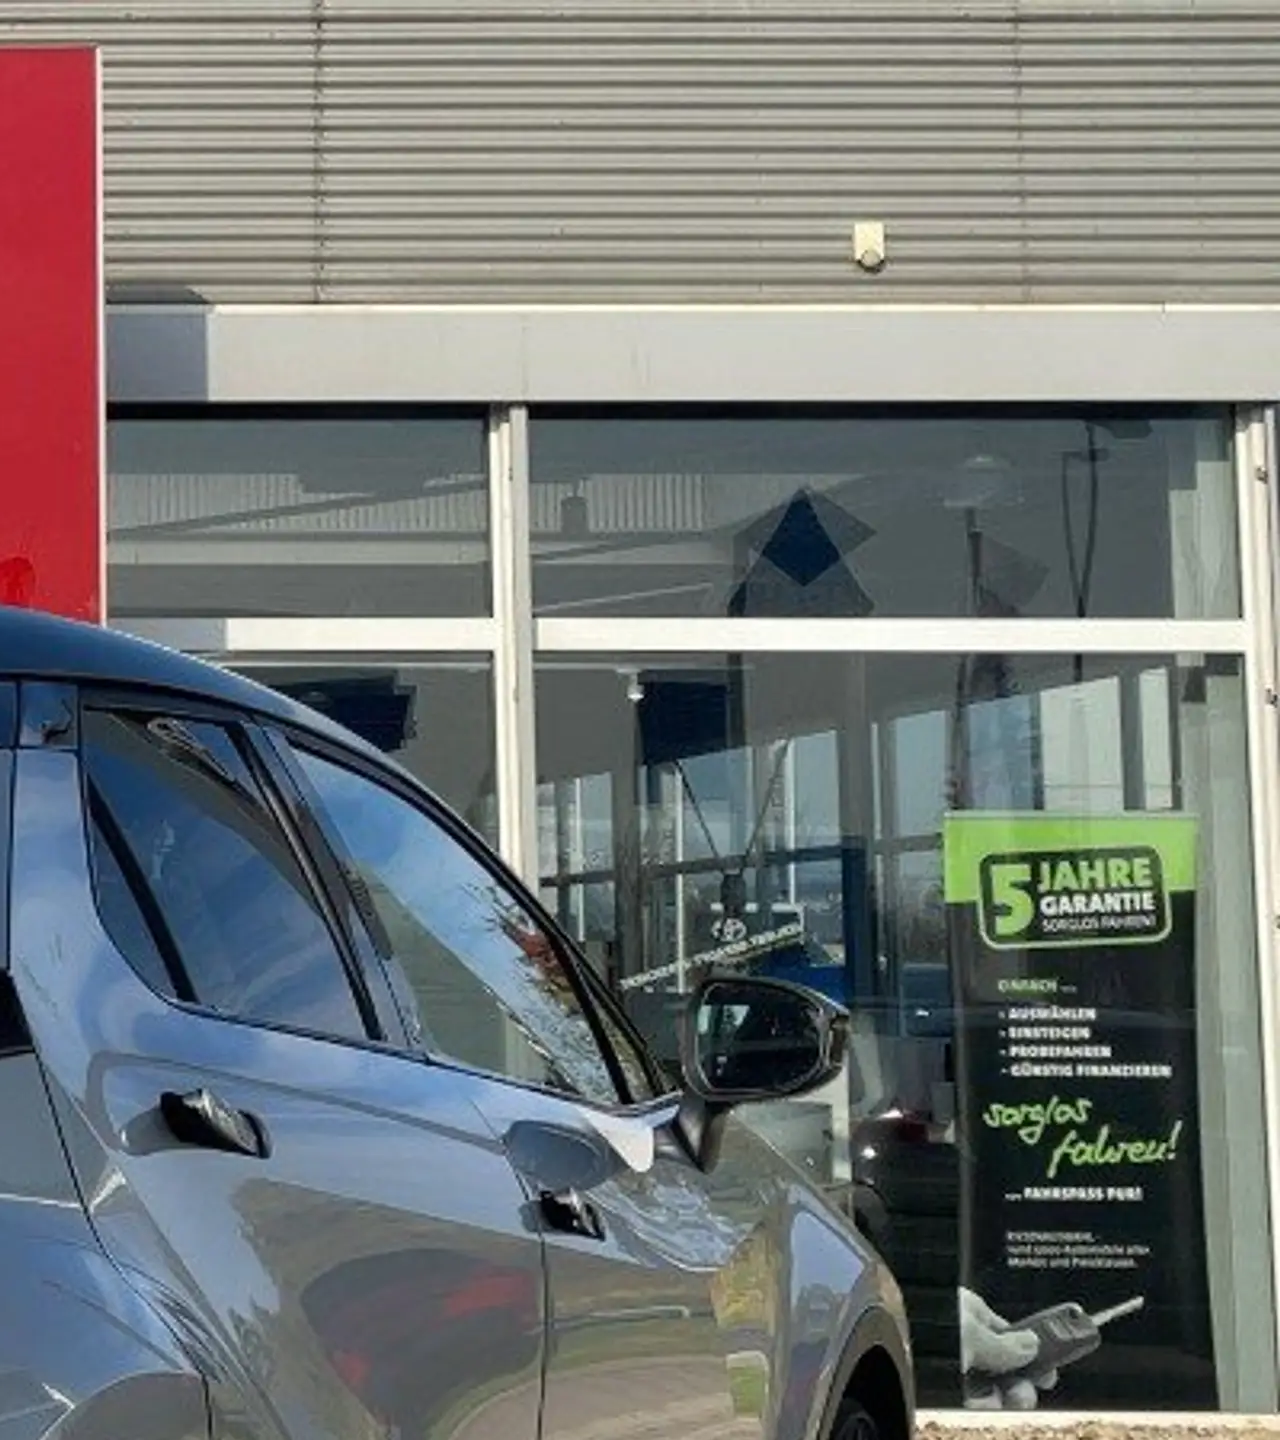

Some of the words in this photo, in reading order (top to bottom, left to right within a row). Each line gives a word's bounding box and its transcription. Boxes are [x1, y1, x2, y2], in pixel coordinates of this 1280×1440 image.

[1038, 857, 1153, 892] JAHRE
[991, 864, 1035, 936] 5
[1039, 891, 1156, 916] GARANTIE
